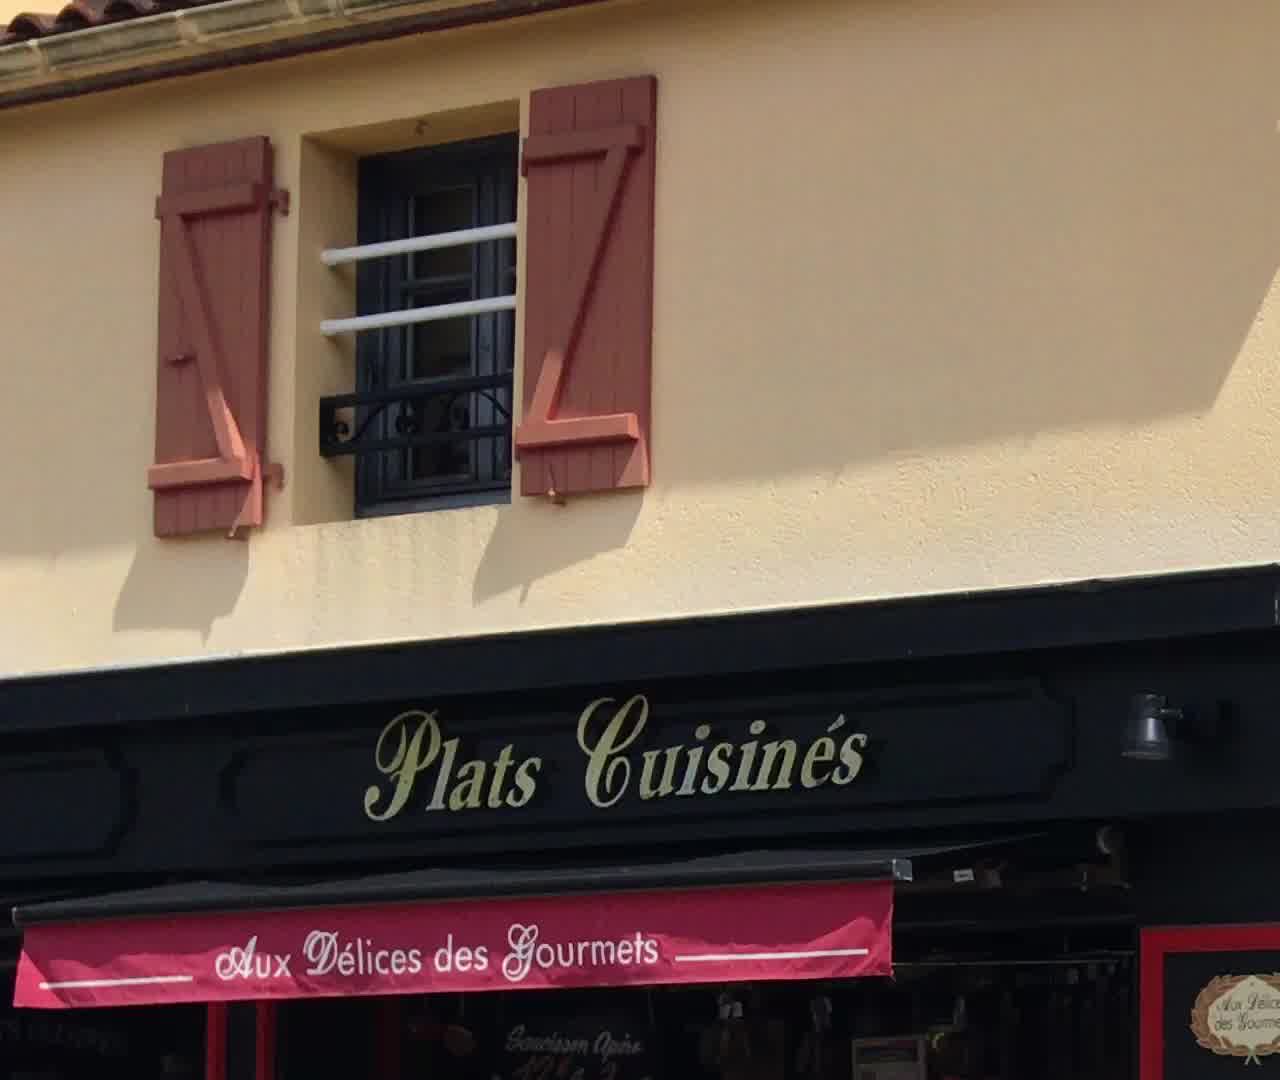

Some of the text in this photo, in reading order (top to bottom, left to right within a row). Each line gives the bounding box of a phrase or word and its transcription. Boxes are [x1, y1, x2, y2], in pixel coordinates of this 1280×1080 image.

[364, 694, 868, 821] Plats Cuisinés
[215, 924, 658, 982] Aux Délices des Gourmets
